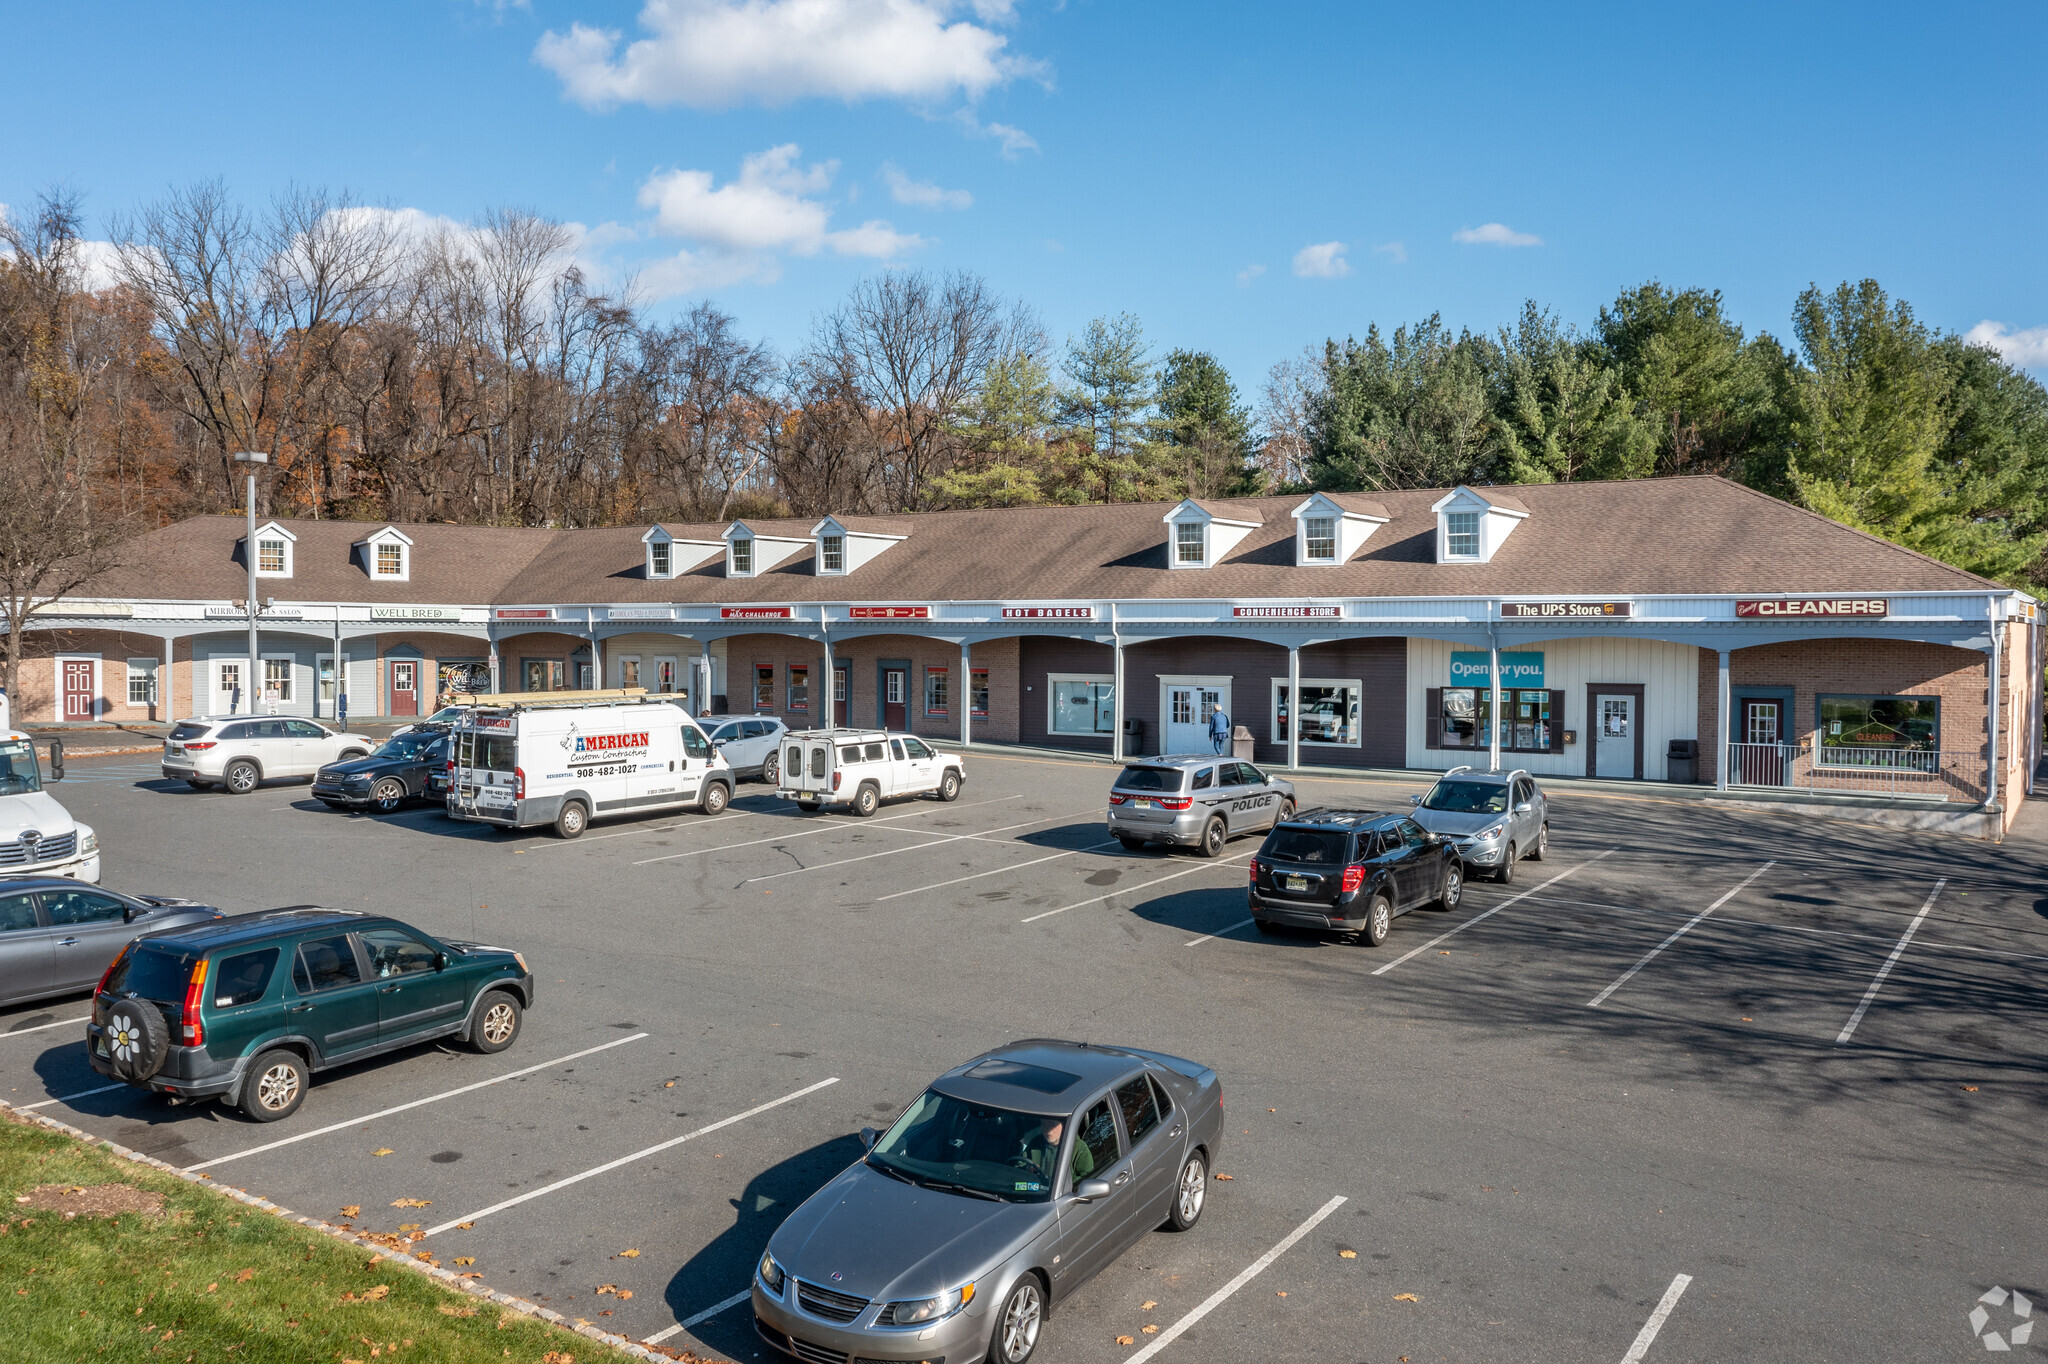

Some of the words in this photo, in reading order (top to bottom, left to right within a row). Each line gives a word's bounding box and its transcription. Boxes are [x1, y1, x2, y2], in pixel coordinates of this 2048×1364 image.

[375, 609, 408, 617] WELL
[412, 609, 442, 618] BRED
[1006, 609, 1029, 617] HOT
[1037, 608, 1088, 617] BAGELS
[1240, 608, 1305, 616] CONVENIENCE
[1310, 608, 1335, 616] STORE
[1516, 604, 1538, 615] The
[1541, 604, 1566, 615] UPS
[1569, 604, 1601, 615] Store
[1758, 601, 1885, 615] CLEANERS
[1451, 662, 1488, 677] Open
[1513, 663, 1542, 678] you.
[475, 717, 511, 728] MERICAN
[576, 732, 649, 752] AMERICAN
[1856, 733, 1896, 741] CLEANERS
[570, 753, 600, 762] Custom
[602, 748, 647, 760] Contracting
[576, 764, 637, 778] 908-482-1027
[1232, 795, 1272, 812] POLICE
